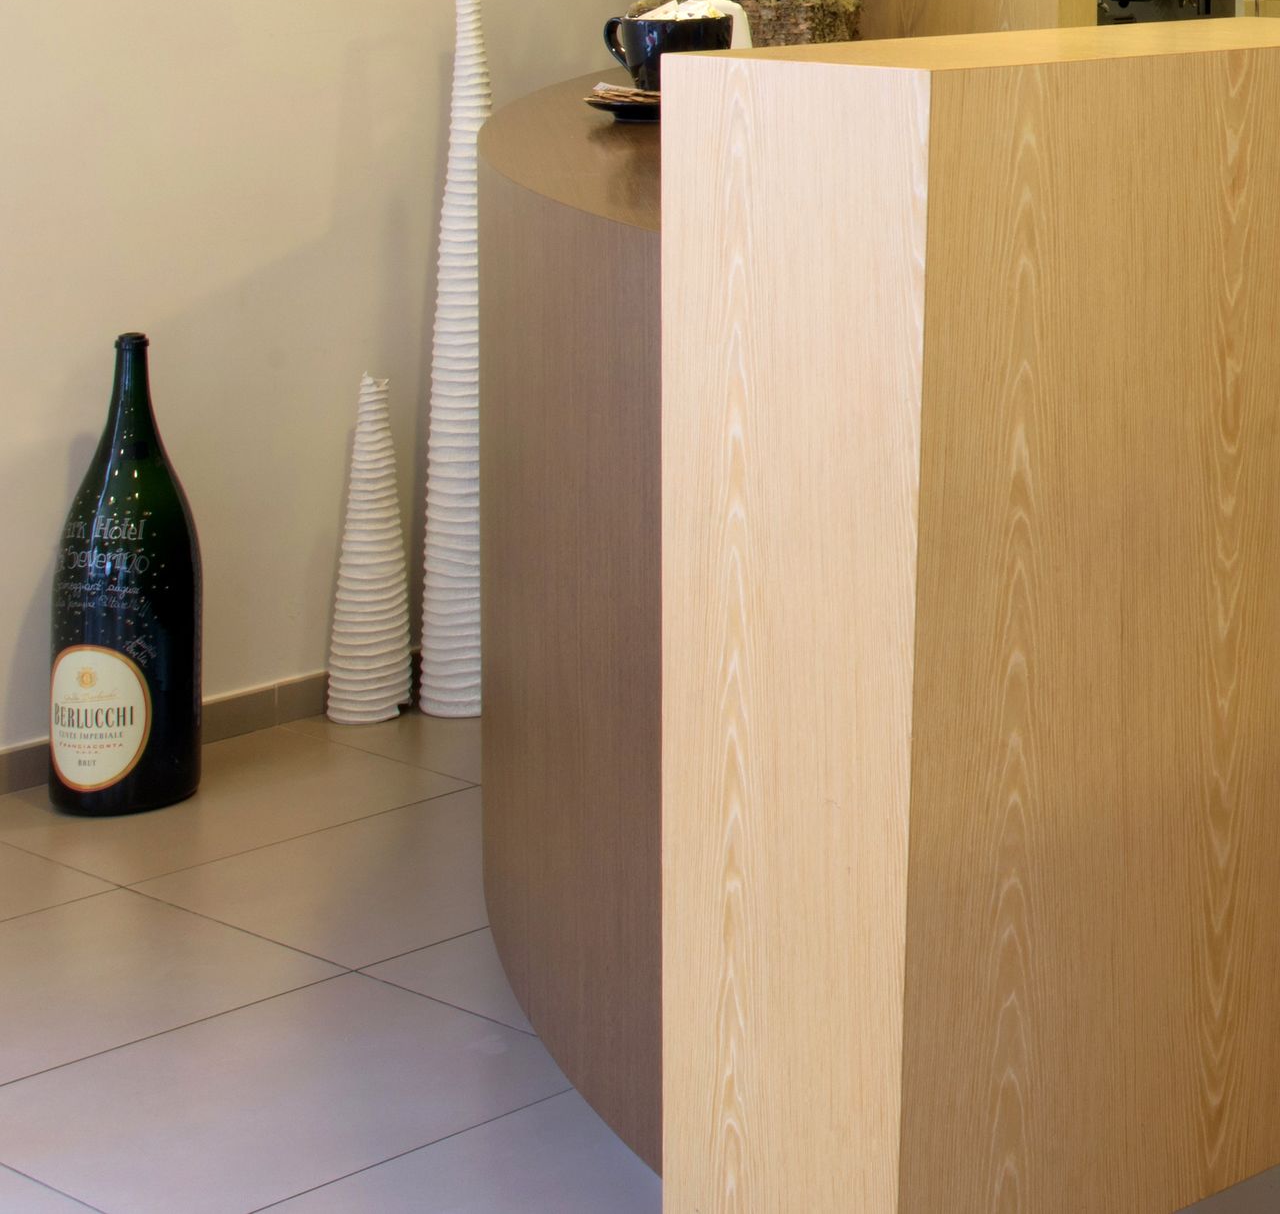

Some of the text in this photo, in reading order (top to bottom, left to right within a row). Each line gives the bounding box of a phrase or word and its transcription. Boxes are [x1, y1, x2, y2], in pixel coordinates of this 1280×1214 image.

[95, 515, 147, 541] Hotel
[67, 546, 151, 574] Severino
[54, 703, 134, 729] BERLUCCHI
[79, 731, 123, 740] IMPERIALE
[77, 758, 97, 767] BRUT
